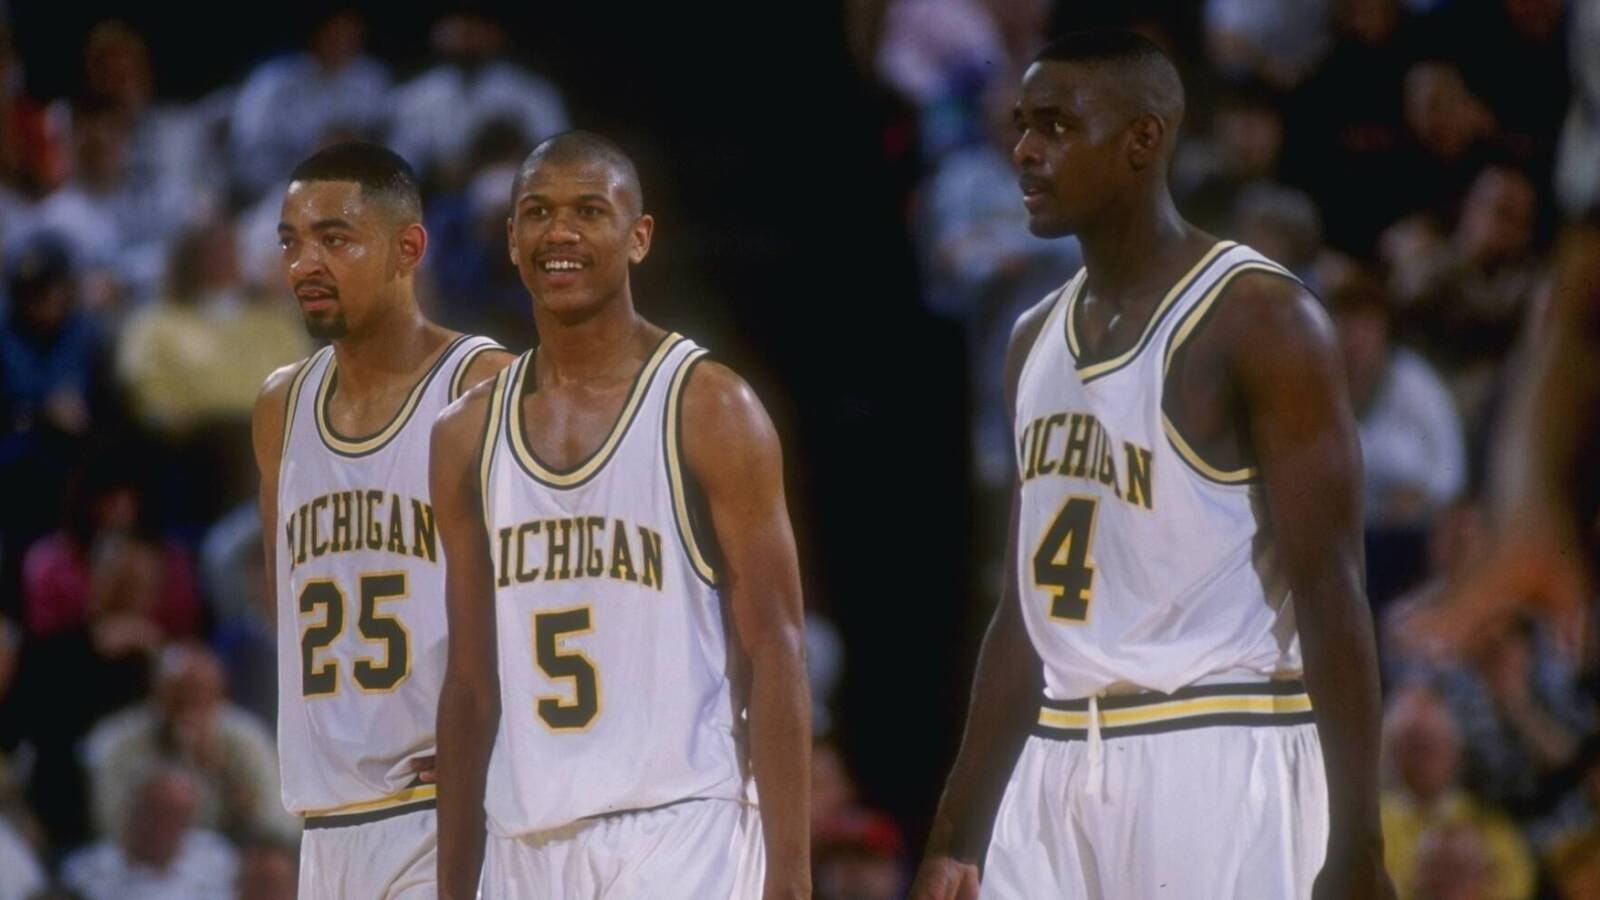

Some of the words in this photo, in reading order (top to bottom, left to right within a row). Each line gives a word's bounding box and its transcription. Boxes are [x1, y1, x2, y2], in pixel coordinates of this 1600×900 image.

[497, 515, 664, 592] ICHIGAN
[1031, 495, 1100, 624] 4
[298, 571, 411, 697] 25
[532, 603, 602, 734] 5
